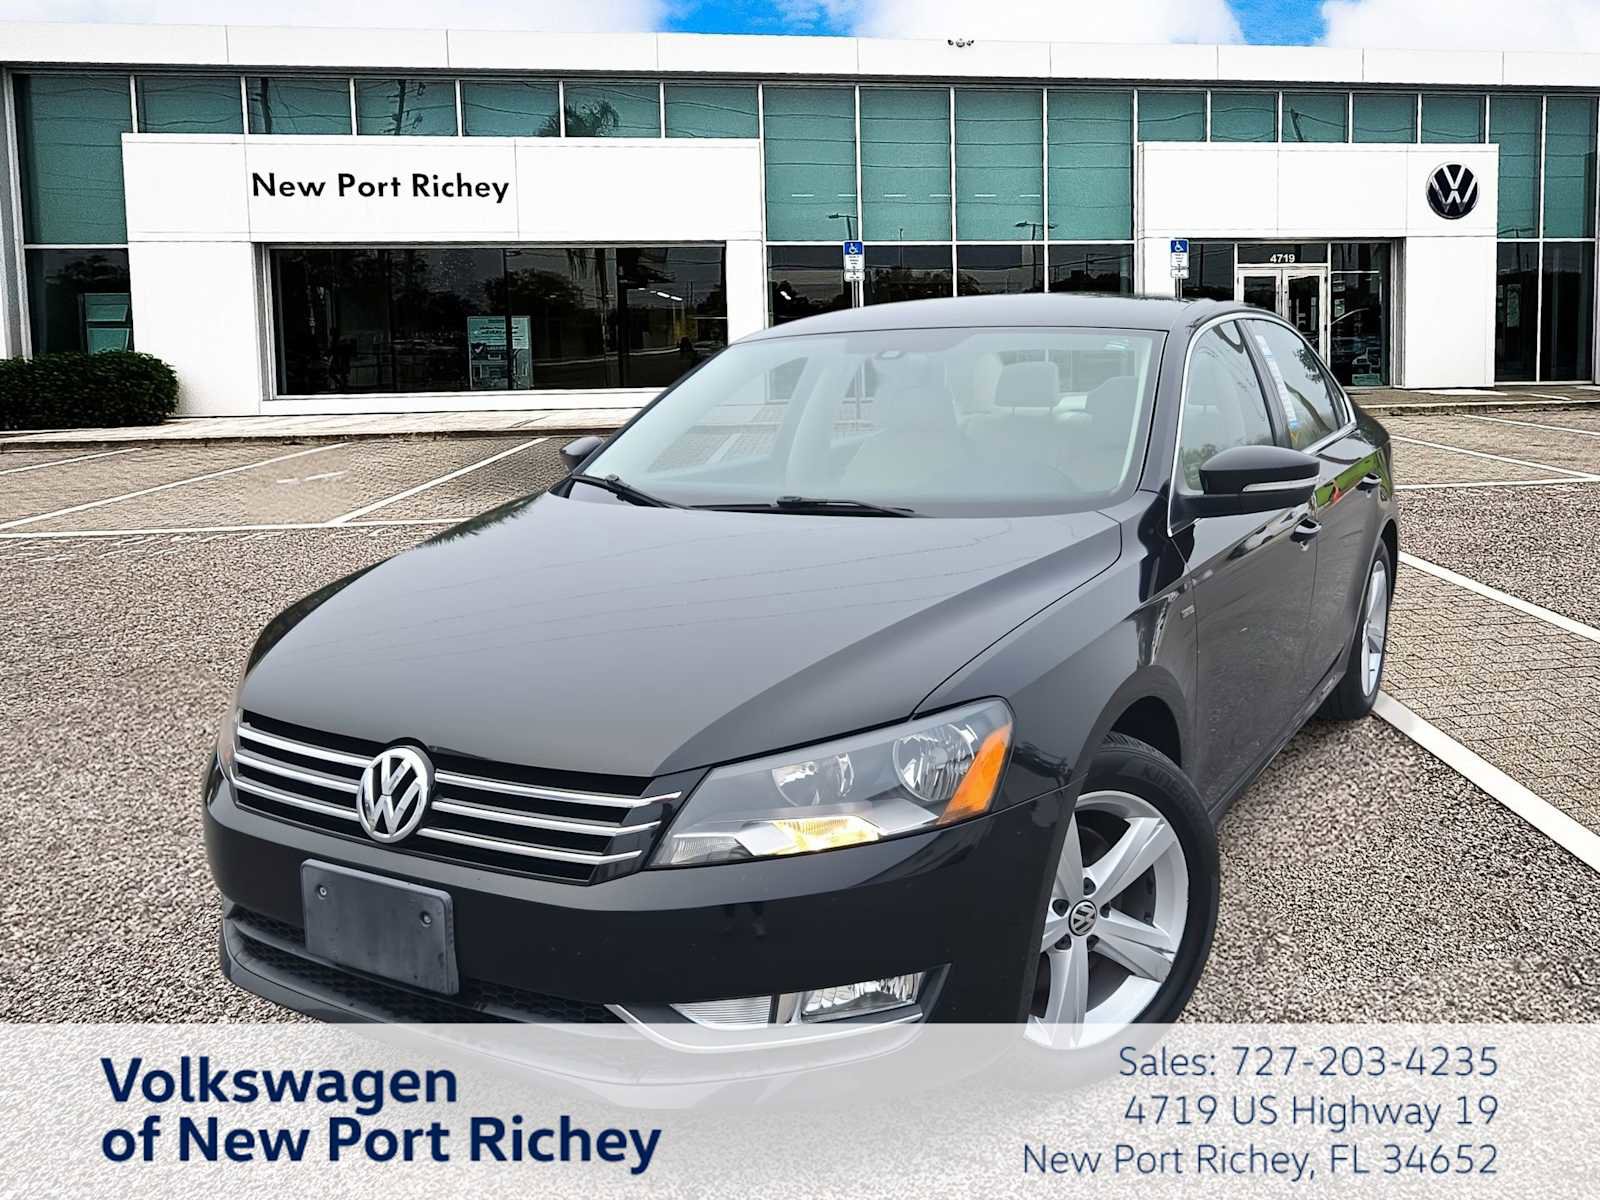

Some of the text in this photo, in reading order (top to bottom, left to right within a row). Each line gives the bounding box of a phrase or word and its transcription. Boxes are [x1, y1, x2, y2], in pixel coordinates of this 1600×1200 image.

[252, 172, 510, 204] New Port Richey
[1270, 253, 1296, 263] 4719
